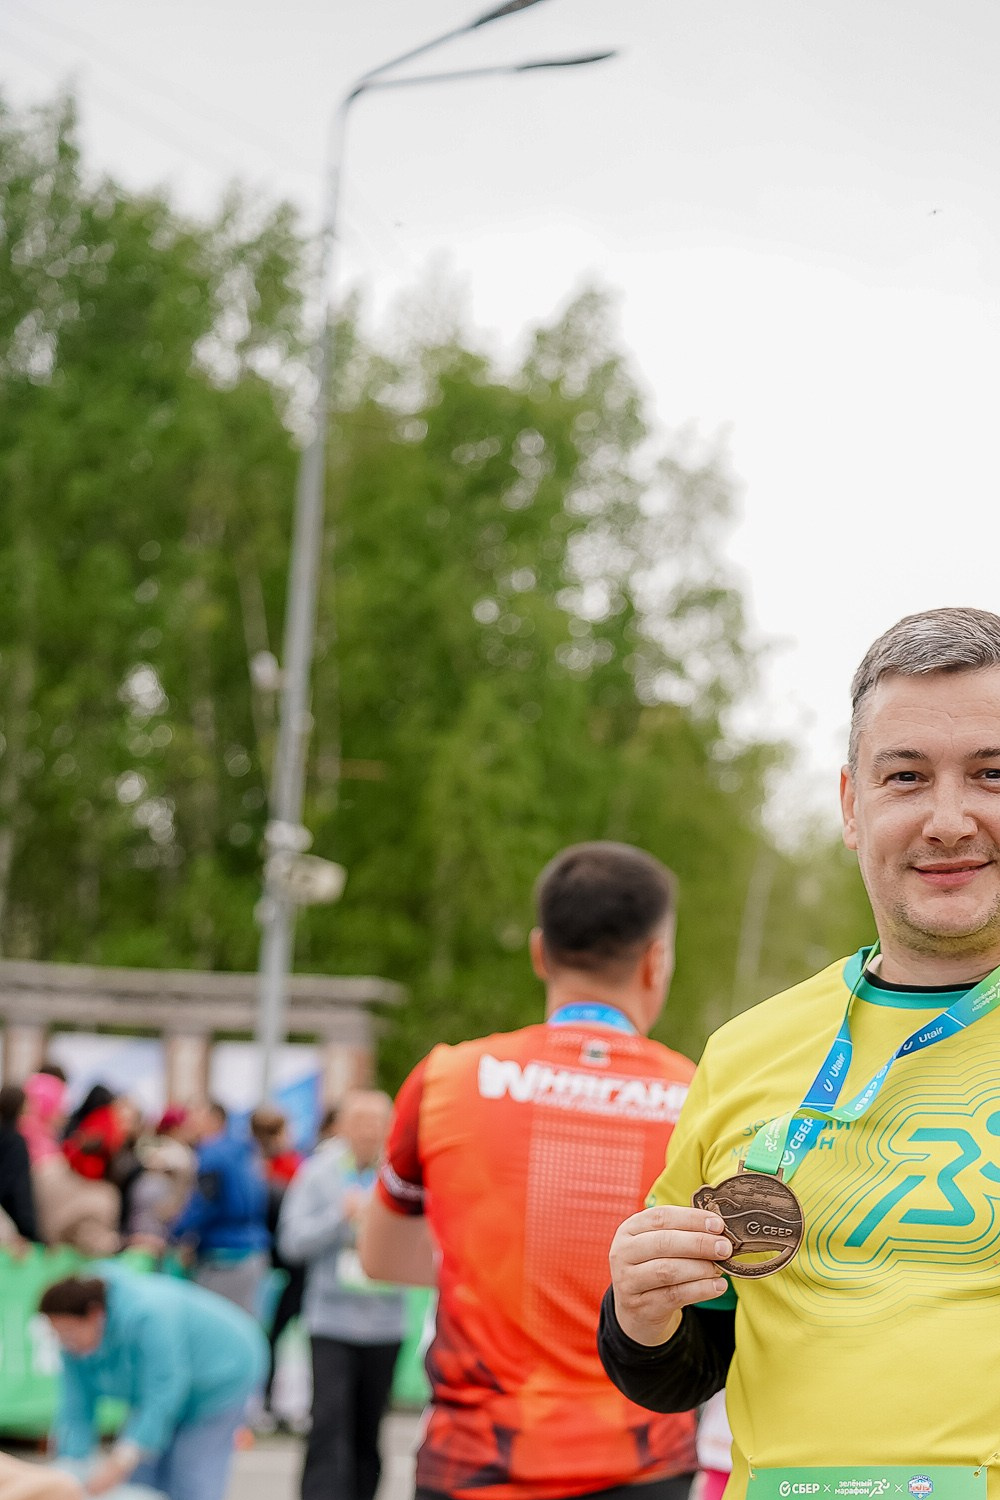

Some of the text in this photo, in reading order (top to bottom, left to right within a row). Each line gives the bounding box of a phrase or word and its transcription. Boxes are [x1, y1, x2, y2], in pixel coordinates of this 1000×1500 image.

[919, 1026, 944, 1043] Utair
[829, 1052, 846, 1077] Utair
[762, 1225, 793, 1238] СБЕР
[791, 1483, 820, 1494] СБЕР
[838, 1478, 873, 1488] зелёный
[834, 1487, 870, 1496] марафон
